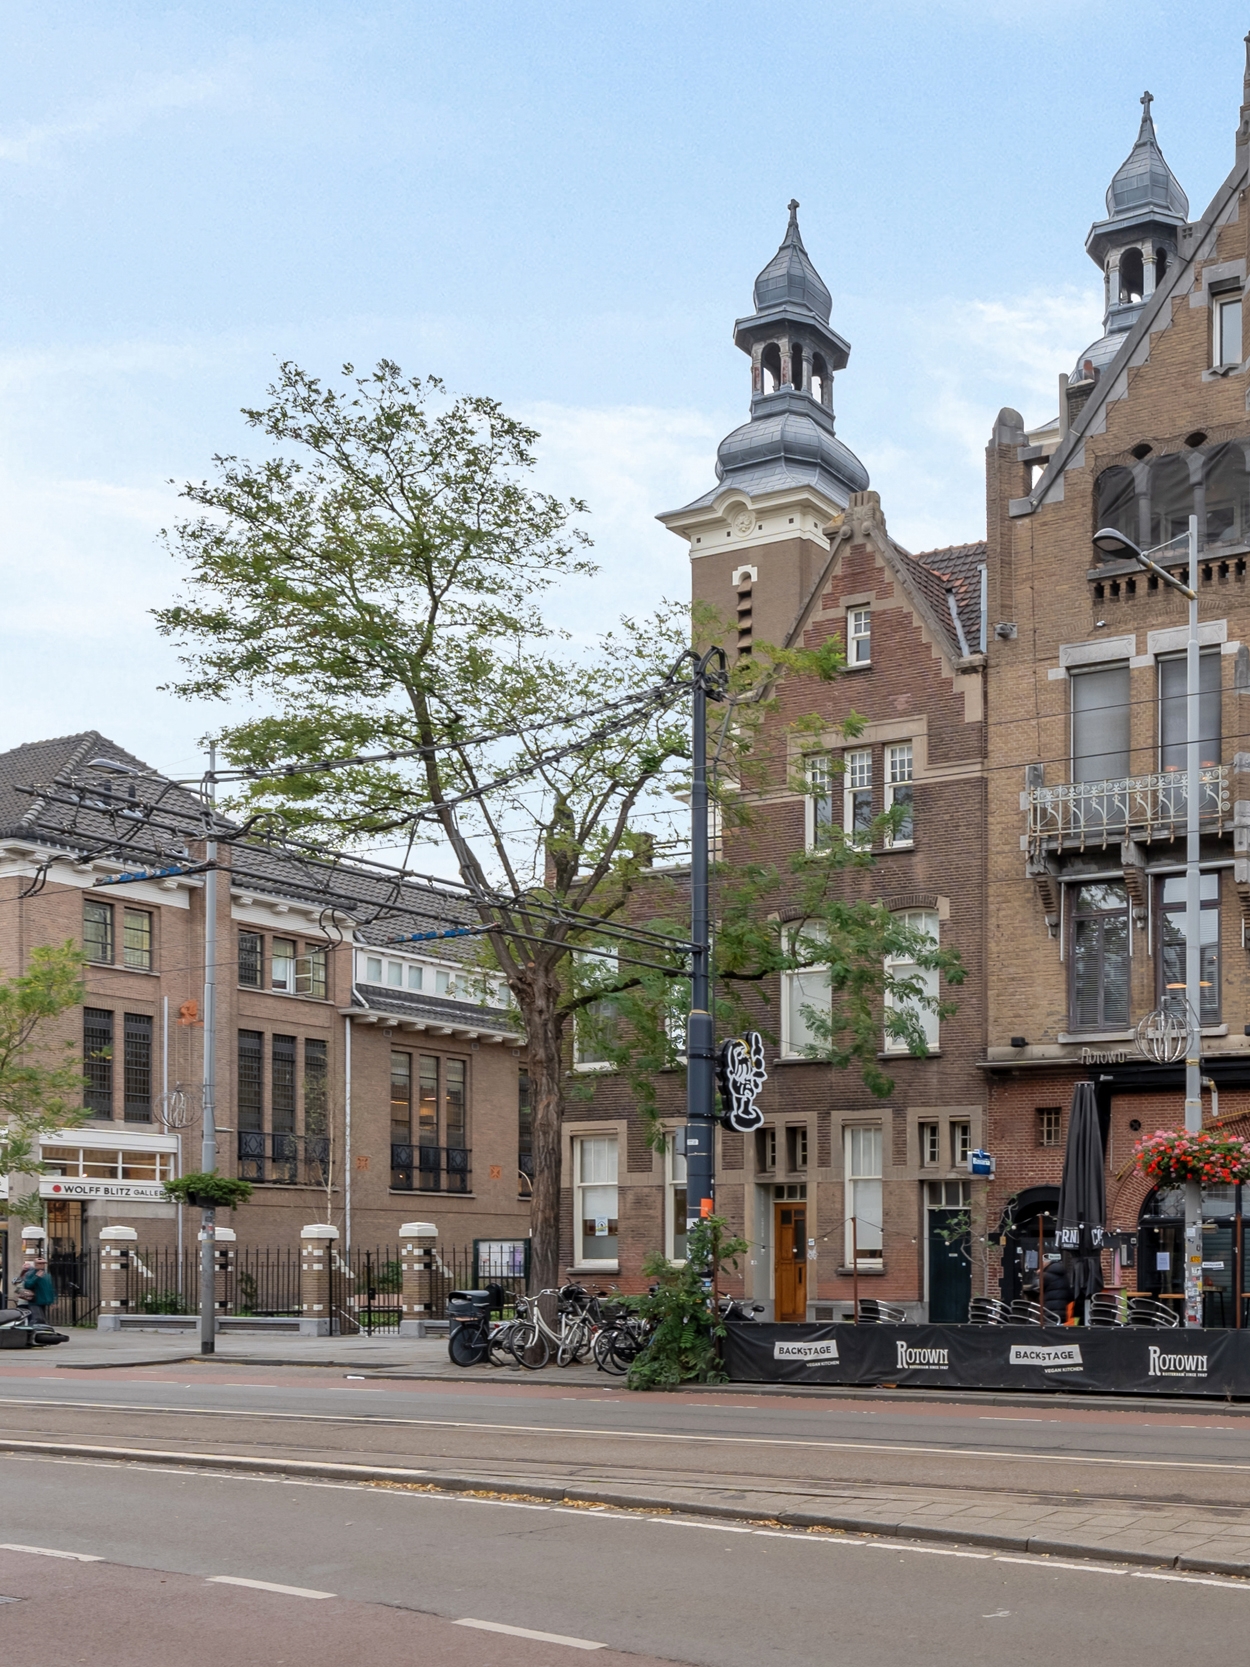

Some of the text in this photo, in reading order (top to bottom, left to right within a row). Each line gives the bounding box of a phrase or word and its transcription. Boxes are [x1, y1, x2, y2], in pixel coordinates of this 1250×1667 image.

[64, 1185, 165, 1197] WOLFF BLITZ GALLER
[778, 1346, 832, 1356] BACKSTAGE
[1015, 1350, 1075, 1361] BACKSTAGE
